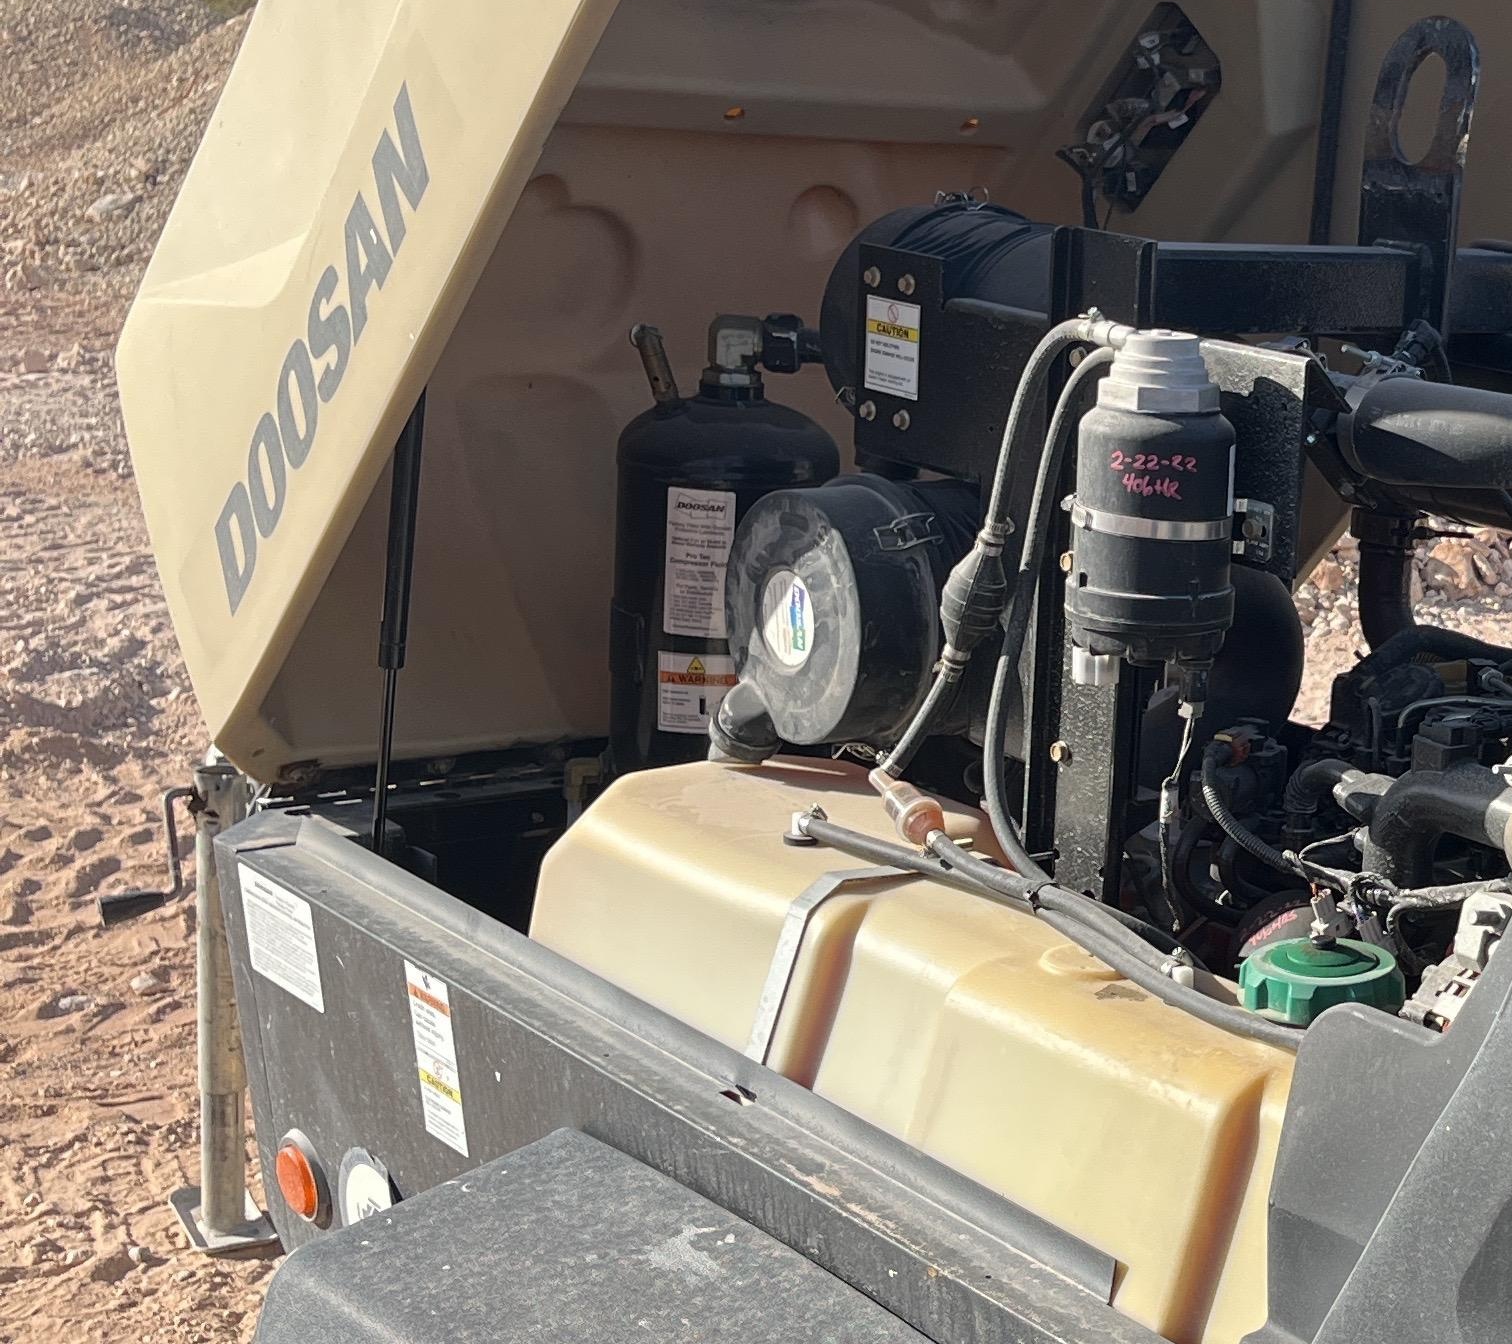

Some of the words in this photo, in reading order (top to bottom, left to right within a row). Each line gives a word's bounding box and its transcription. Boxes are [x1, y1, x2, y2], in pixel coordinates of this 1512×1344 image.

[876, 322, 910, 339] CAUTION
[214, 79, 430, 617] DOOSAN
[1110, 450, 1198, 473] 2-22-22
[677, 500, 726, 513] DOOSAN
